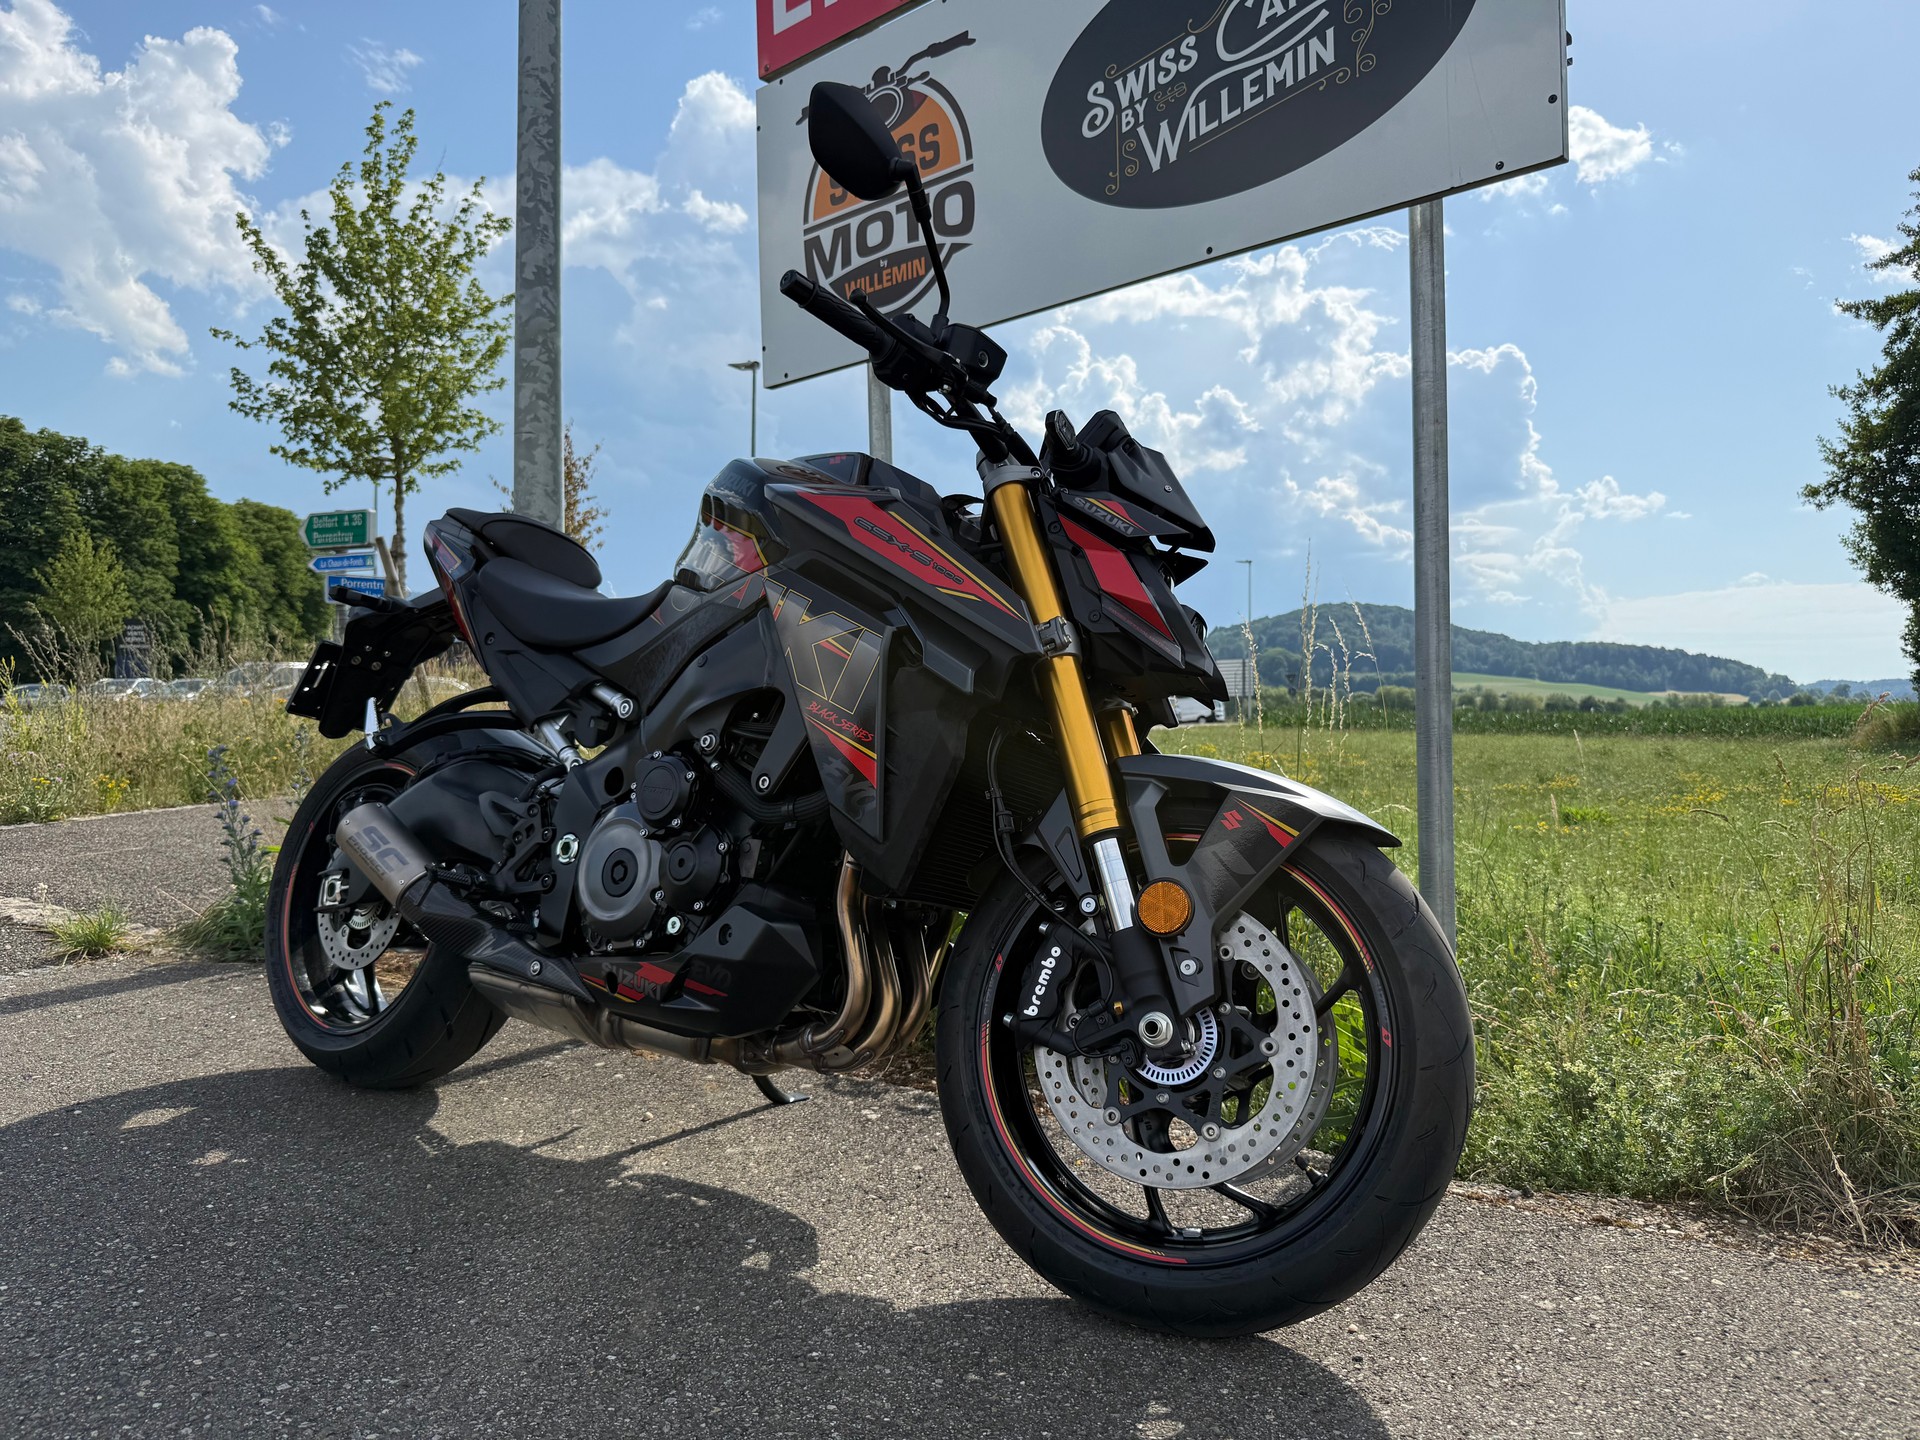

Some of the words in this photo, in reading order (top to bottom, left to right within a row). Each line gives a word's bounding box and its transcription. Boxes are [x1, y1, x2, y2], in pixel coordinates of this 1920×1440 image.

[1082, 35, 1199, 138] SWISS
[1136, 26, 1336, 173] WILLEMIN
[1121, 97, 1148, 134] BY
[804, 181, 975, 284] MOTO
[844, 256, 926, 301] WILLEMIN
[879, 258, 888, 268] by
[343, 514, 350, 527] A
[1072, 496, 1134, 535] SUZUKI
[312, 531, 353, 544] Porrentruy
[854, 516, 934, 567] GSX-S
[932, 562, 965, 585] 1000
[806, 701, 838, 724] BLACK
[836, 719, 874, 742] SERIES
[354, 825, 410, 873] SC
[602, 962, 662, 1001] SUZUKI
[1023, 946, 1061, 1016] brembo
